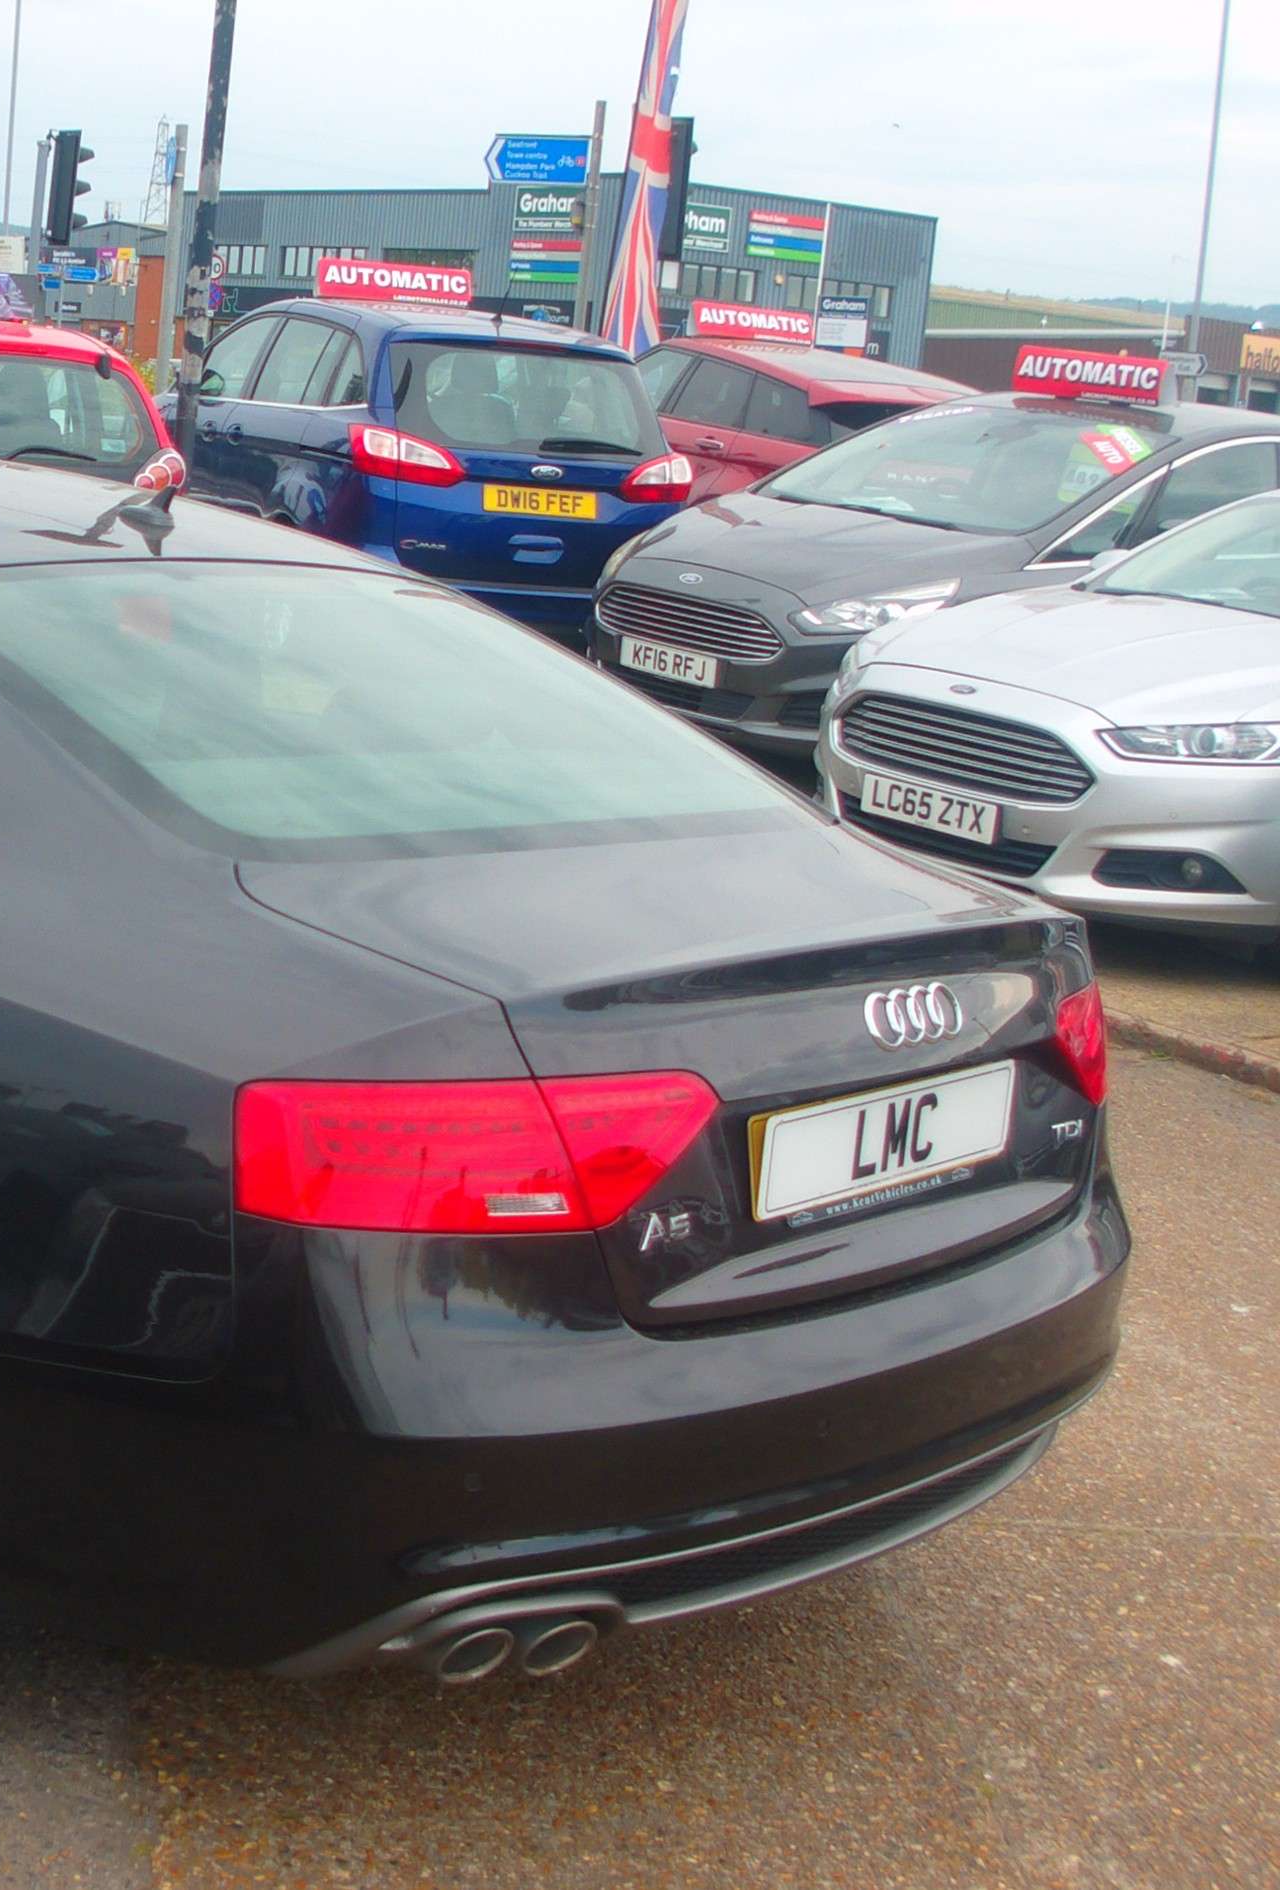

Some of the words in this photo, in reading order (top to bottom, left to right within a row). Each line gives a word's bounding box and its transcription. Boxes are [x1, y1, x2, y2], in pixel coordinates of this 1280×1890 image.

[685, 211, 726, 233] ham
[324, 265, 467, 293] AUTOMATIC
[822, 299, 866, 310] Graham
[700, 307, 809, 334] AUTOMATIC
[1017, 355, 1159, 390] AUTOMATIC
[1092, 440, 1125, 463] AUTO
[496, 489, 540, 511] DW16
[546, 494, 584, 514] FEF
[631, 643, 668, 674] KF16
[671, 652, 707, 682] RFJ
[871, 779, 934, 821] LC65
[936, 798, 987, 834] ZTX
[851, 1093, 938, 1181] LMC
[1051, 1118, 1084, 1144] TDI
[639, 1212, 692, 1252] A5
